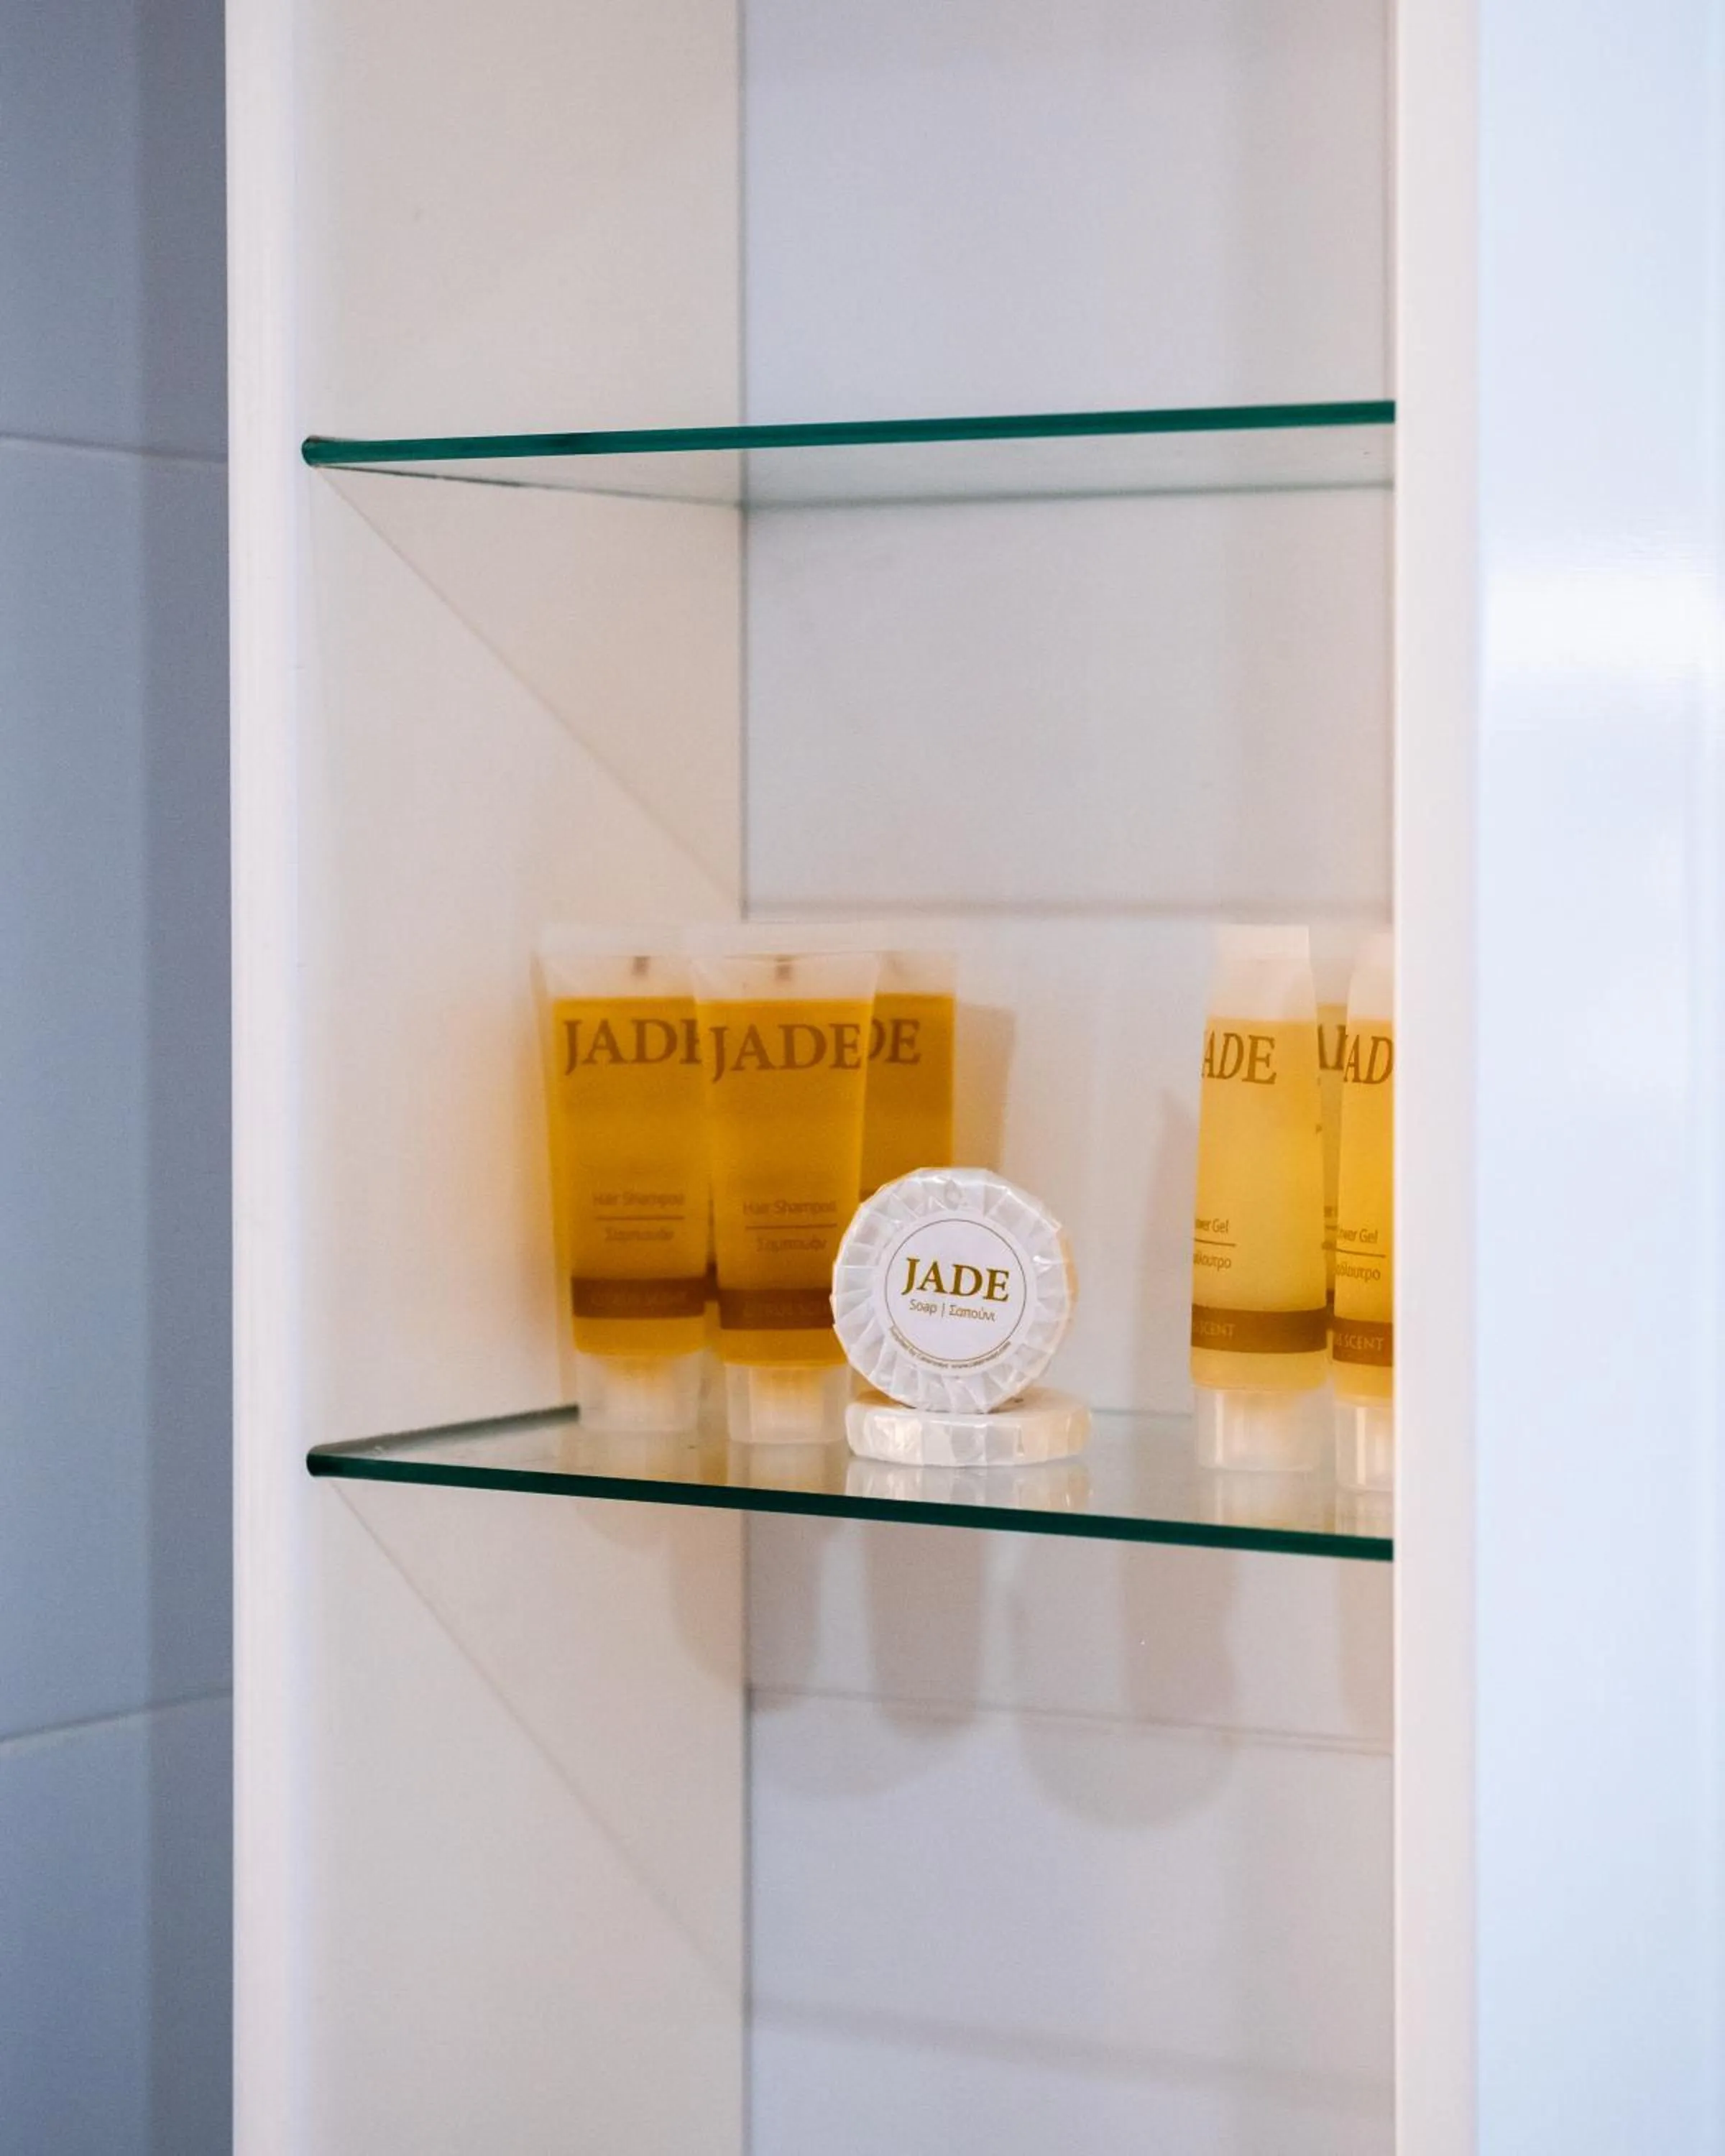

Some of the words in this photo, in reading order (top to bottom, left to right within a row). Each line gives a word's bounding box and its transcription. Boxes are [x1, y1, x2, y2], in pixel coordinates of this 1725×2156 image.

[709, 1023, 862, 1082] JADE
[1342, 1033, 1393, 1085] AD
[1212, 1218, 1229, 1234] Gel
[1359, 1227, 1378, 1245] Gel
[900, 1256, 1010, 1302] JADE
[908, 1299, 937, 1317] Soap
[948, 1304, 996, 1322] Σαπούνι
